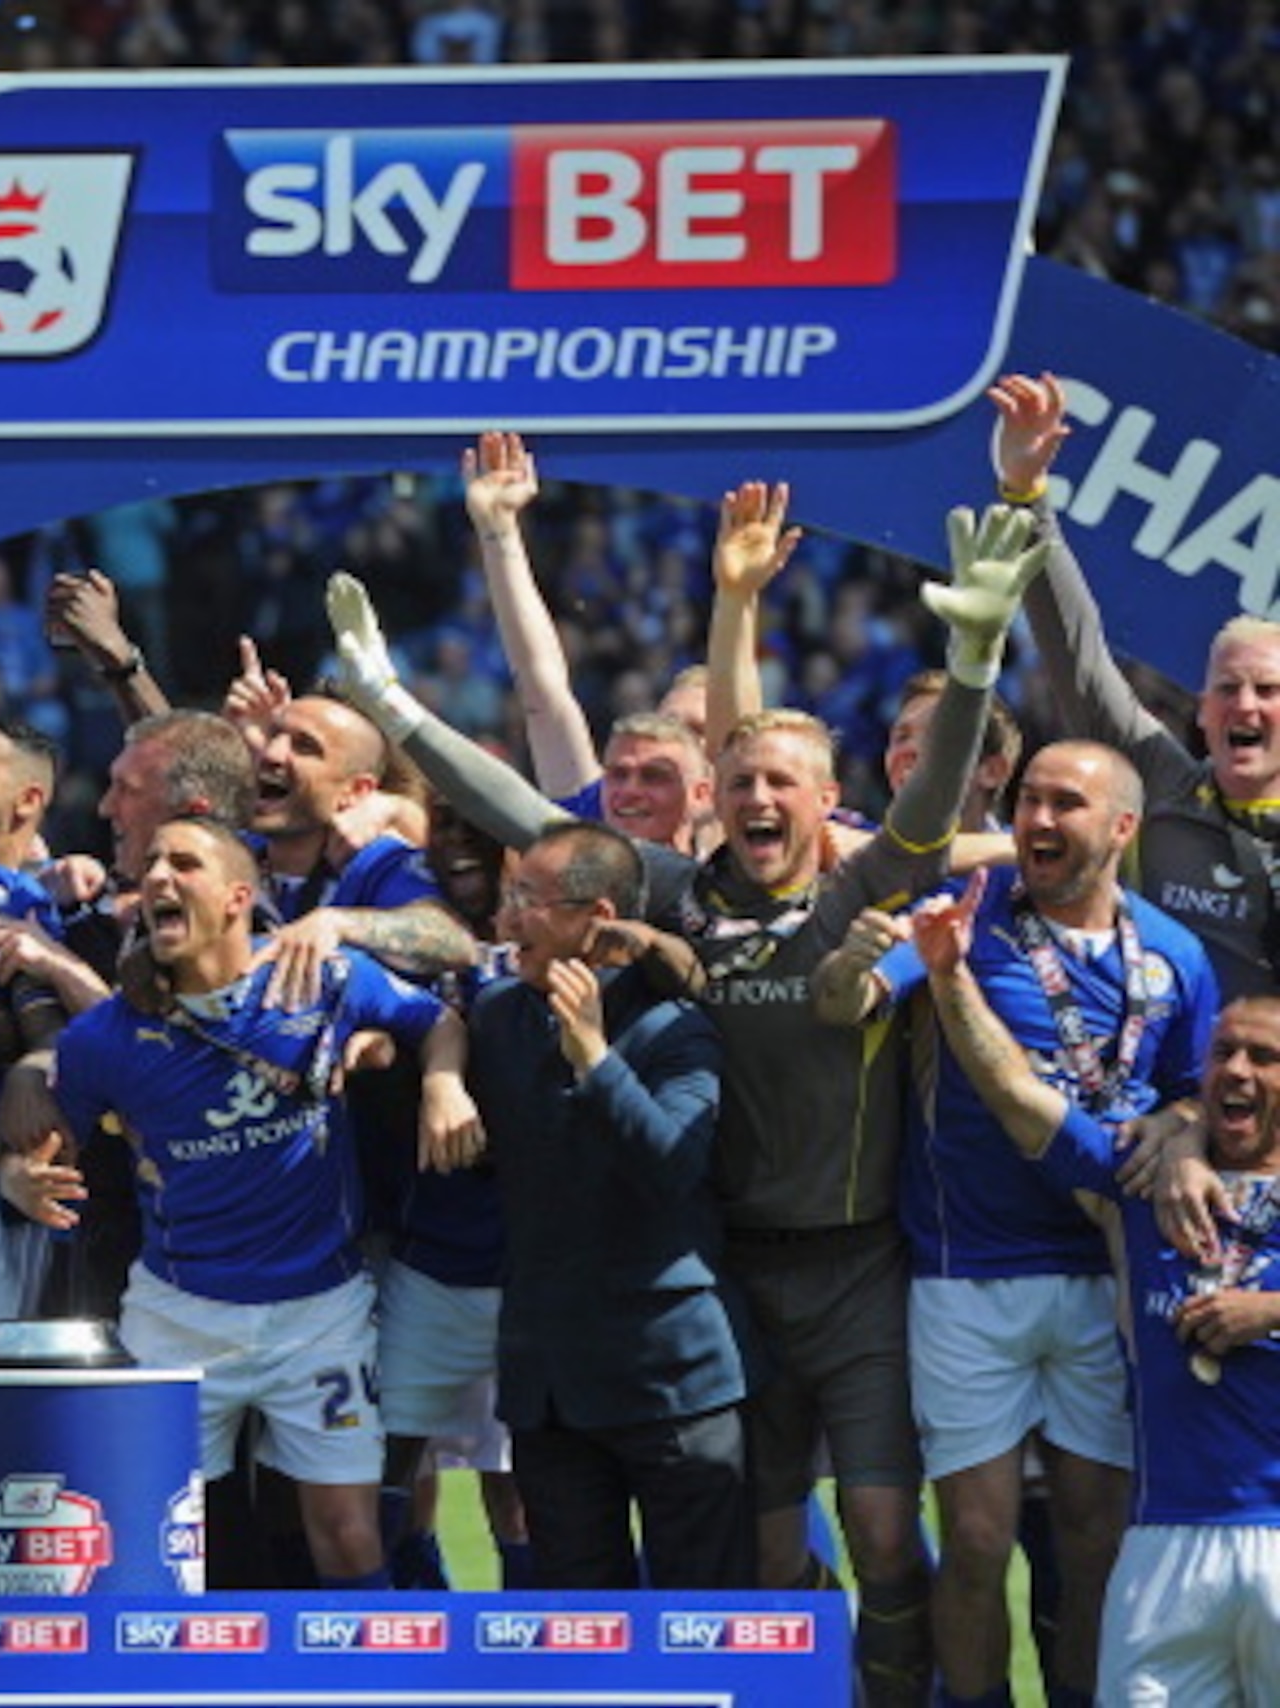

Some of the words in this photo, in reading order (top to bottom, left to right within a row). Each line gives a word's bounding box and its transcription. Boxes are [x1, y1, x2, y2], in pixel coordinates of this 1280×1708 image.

[243, 137, 486, 284] sky
[545, 145, 859, 264] BET
[267, 326, 837, 383] CHAMPIONSHIP
[727, 975, 810, 1004] POWE
[27, 1529, 101, 1562] BET
[10, 1617, 77, 1647] BET
[125, 1615, 179, 1649] sky
[188, 1618, 255, 1647] BET
[305, 1615, 361, 1649] sky
[370, 1618, 437, 1646] BET
[485, 1615, 541, 1649] sky
[550, 1618, 618, 1646] BET
[668, 1615, 724, 1649] sky
[733, 1617, 804, 1646] BET
